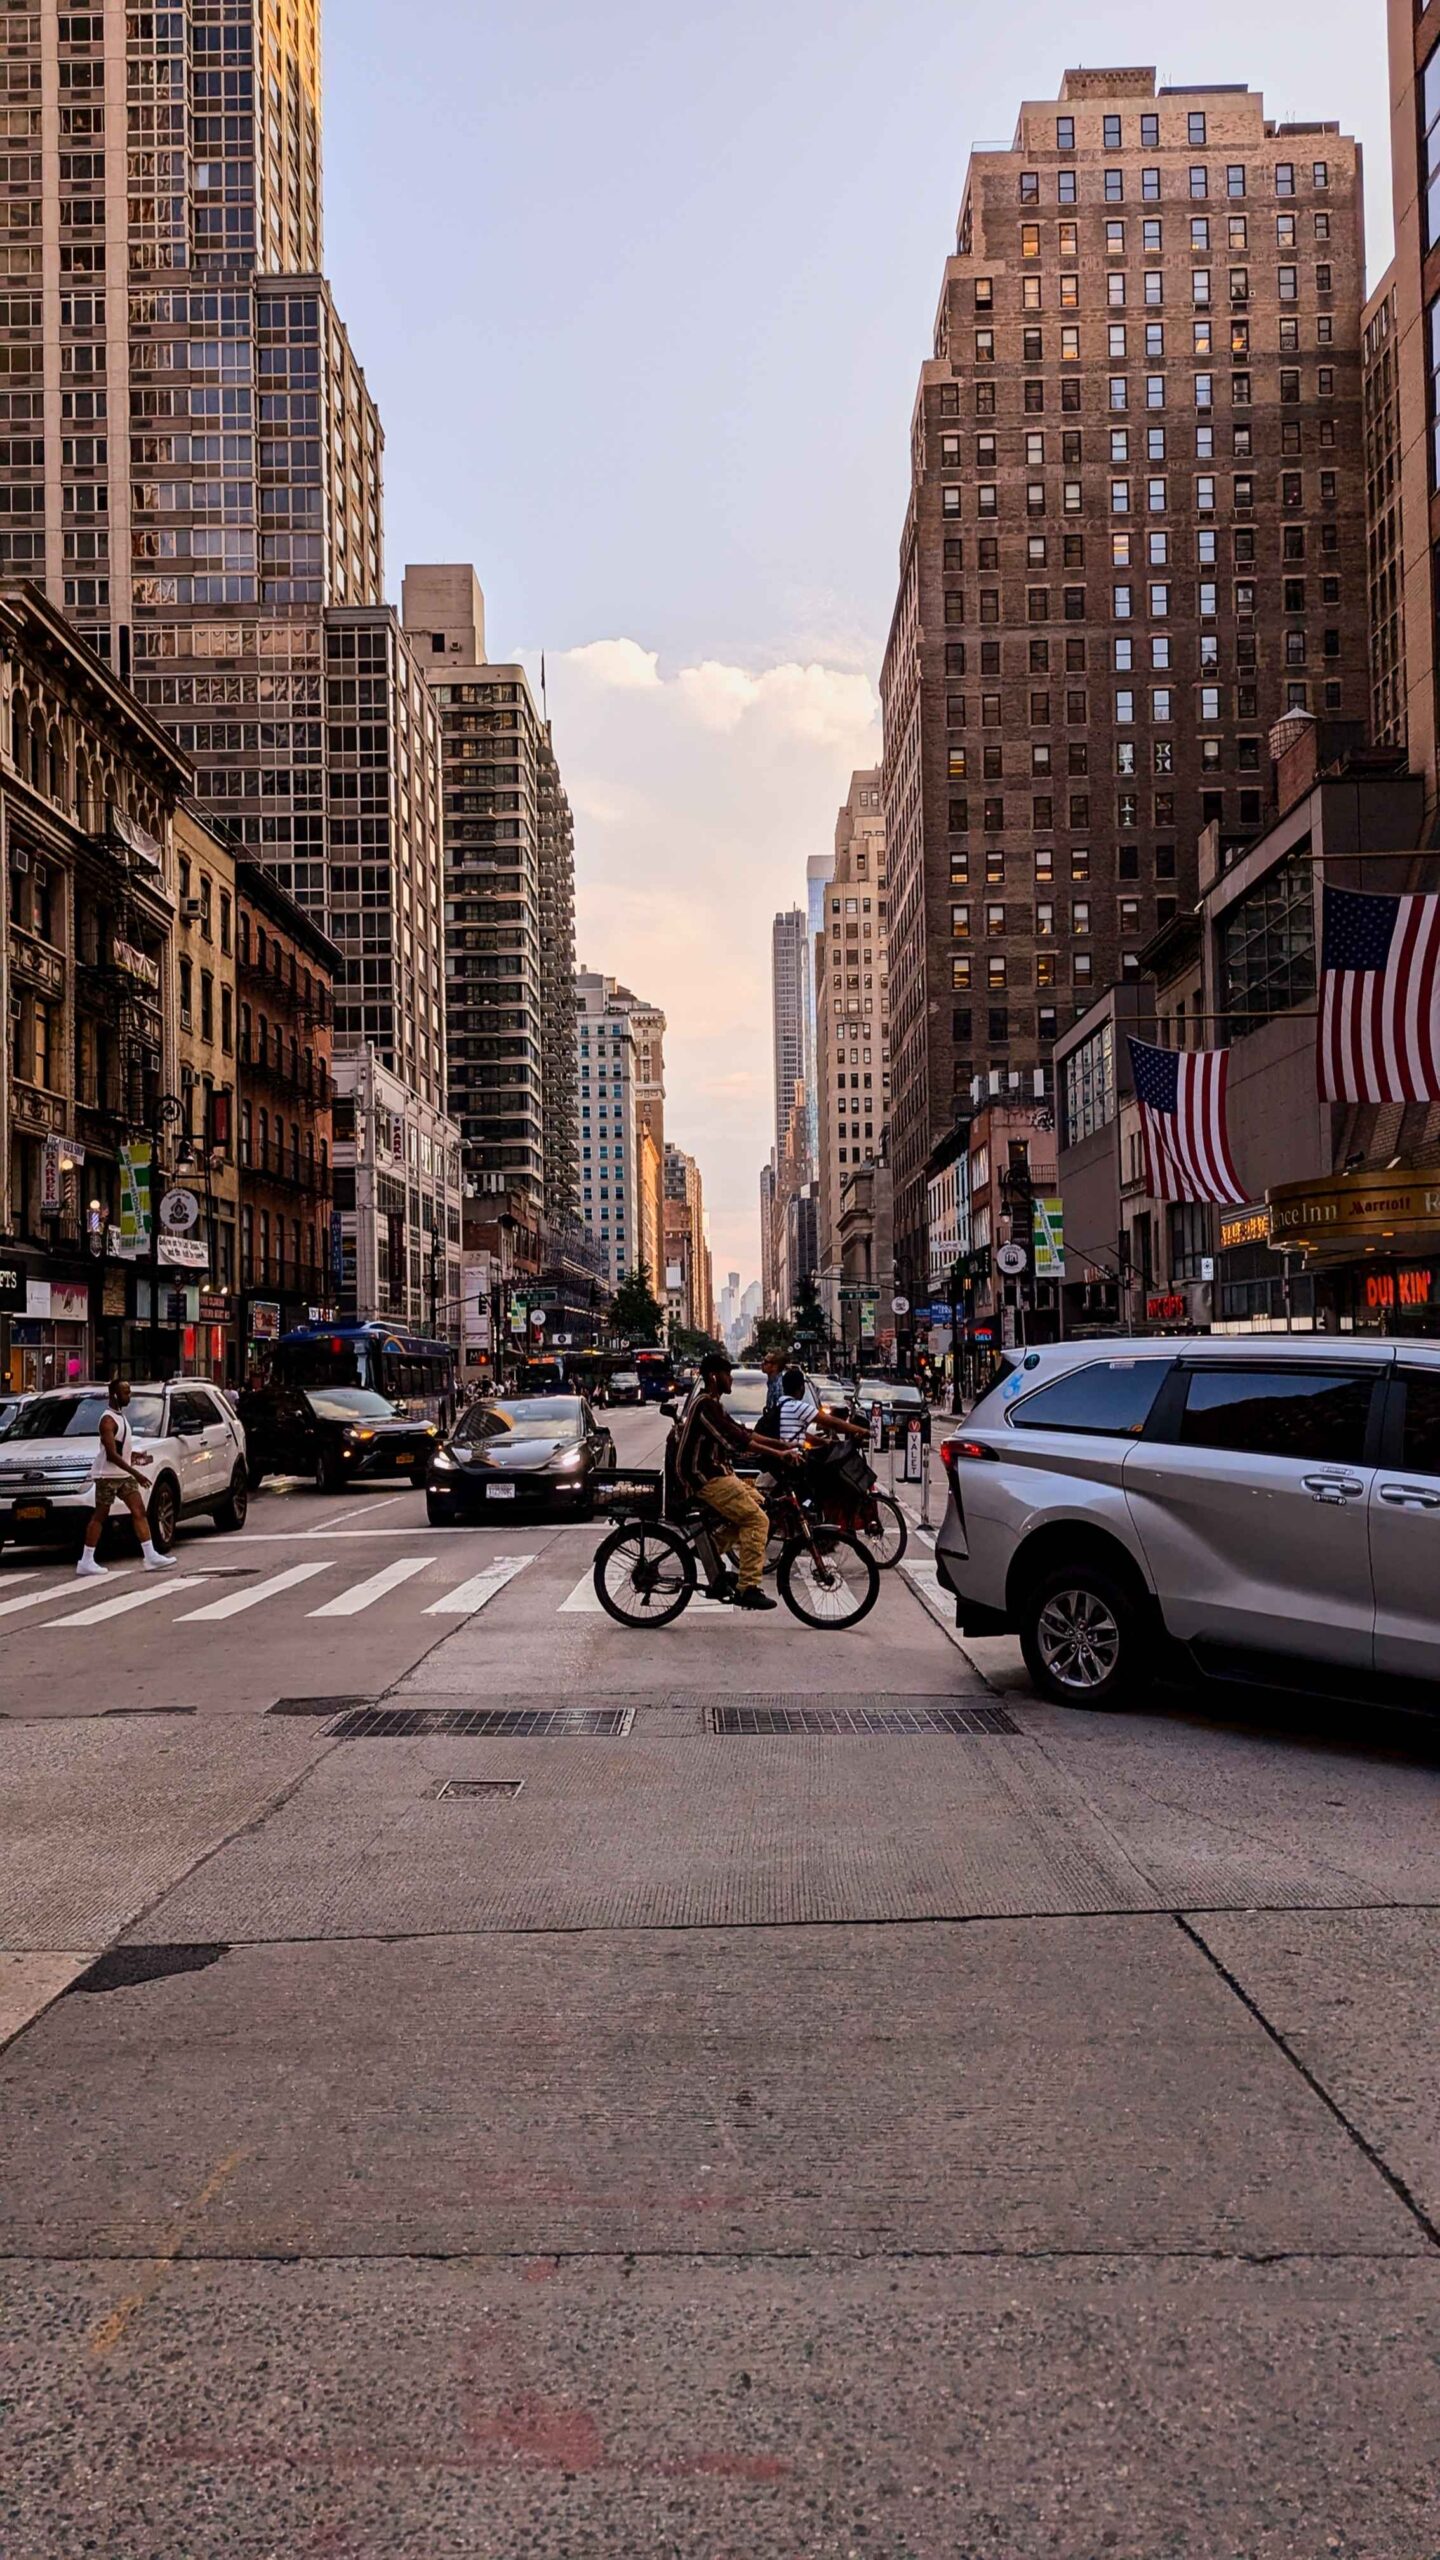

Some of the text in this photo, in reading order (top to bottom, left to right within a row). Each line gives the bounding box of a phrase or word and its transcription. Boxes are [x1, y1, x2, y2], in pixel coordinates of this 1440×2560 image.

[393, 1126, 401, 1154] PARK
[45, 1152, 55, 1200] BARBER
[1302, 1202, 1337, 1224] Inn
[1350, 1196, 1411, 1216] Marriott
[911, 1420, 919, 1431] V
[910, 1434, 918, 1475] VALET
